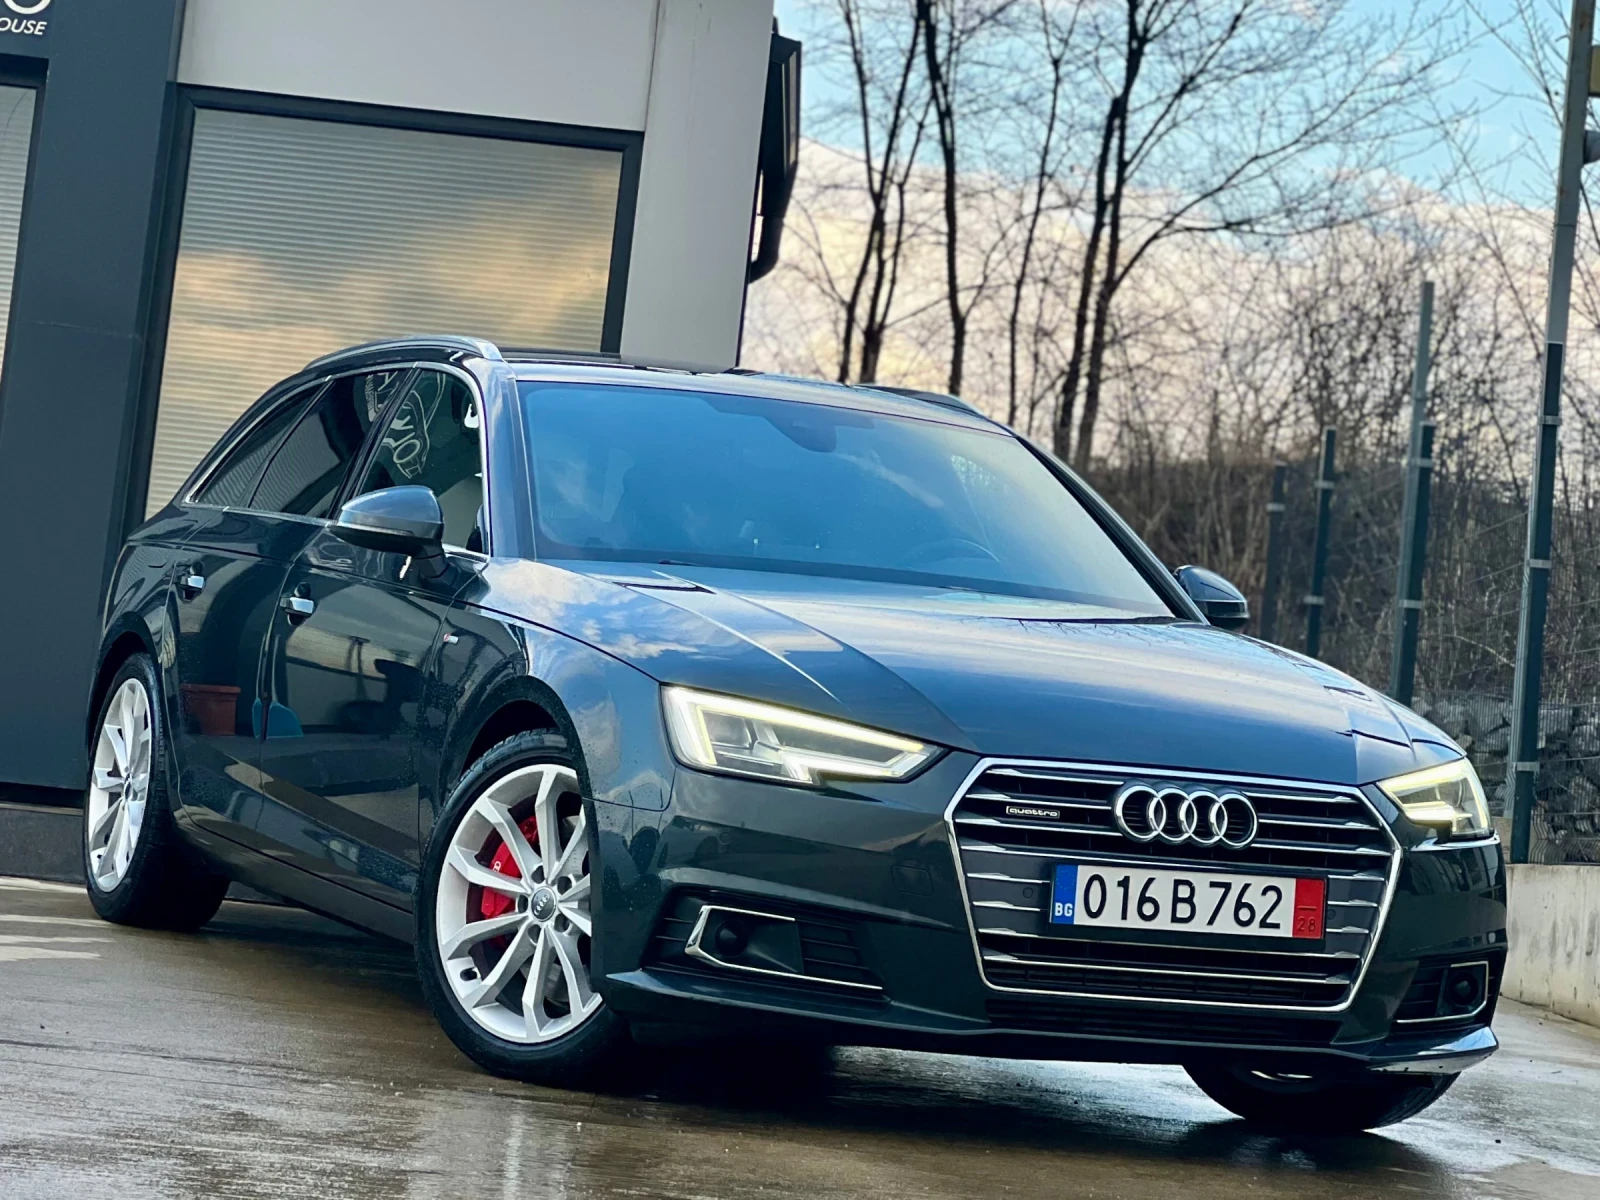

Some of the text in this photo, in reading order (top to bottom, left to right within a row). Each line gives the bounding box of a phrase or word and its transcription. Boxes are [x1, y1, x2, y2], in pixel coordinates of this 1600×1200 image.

[1009, 808, 1058, 817] quattro
[1054, 902, 1073, 917] BG
[1297, 916, 1316, 932] 28
